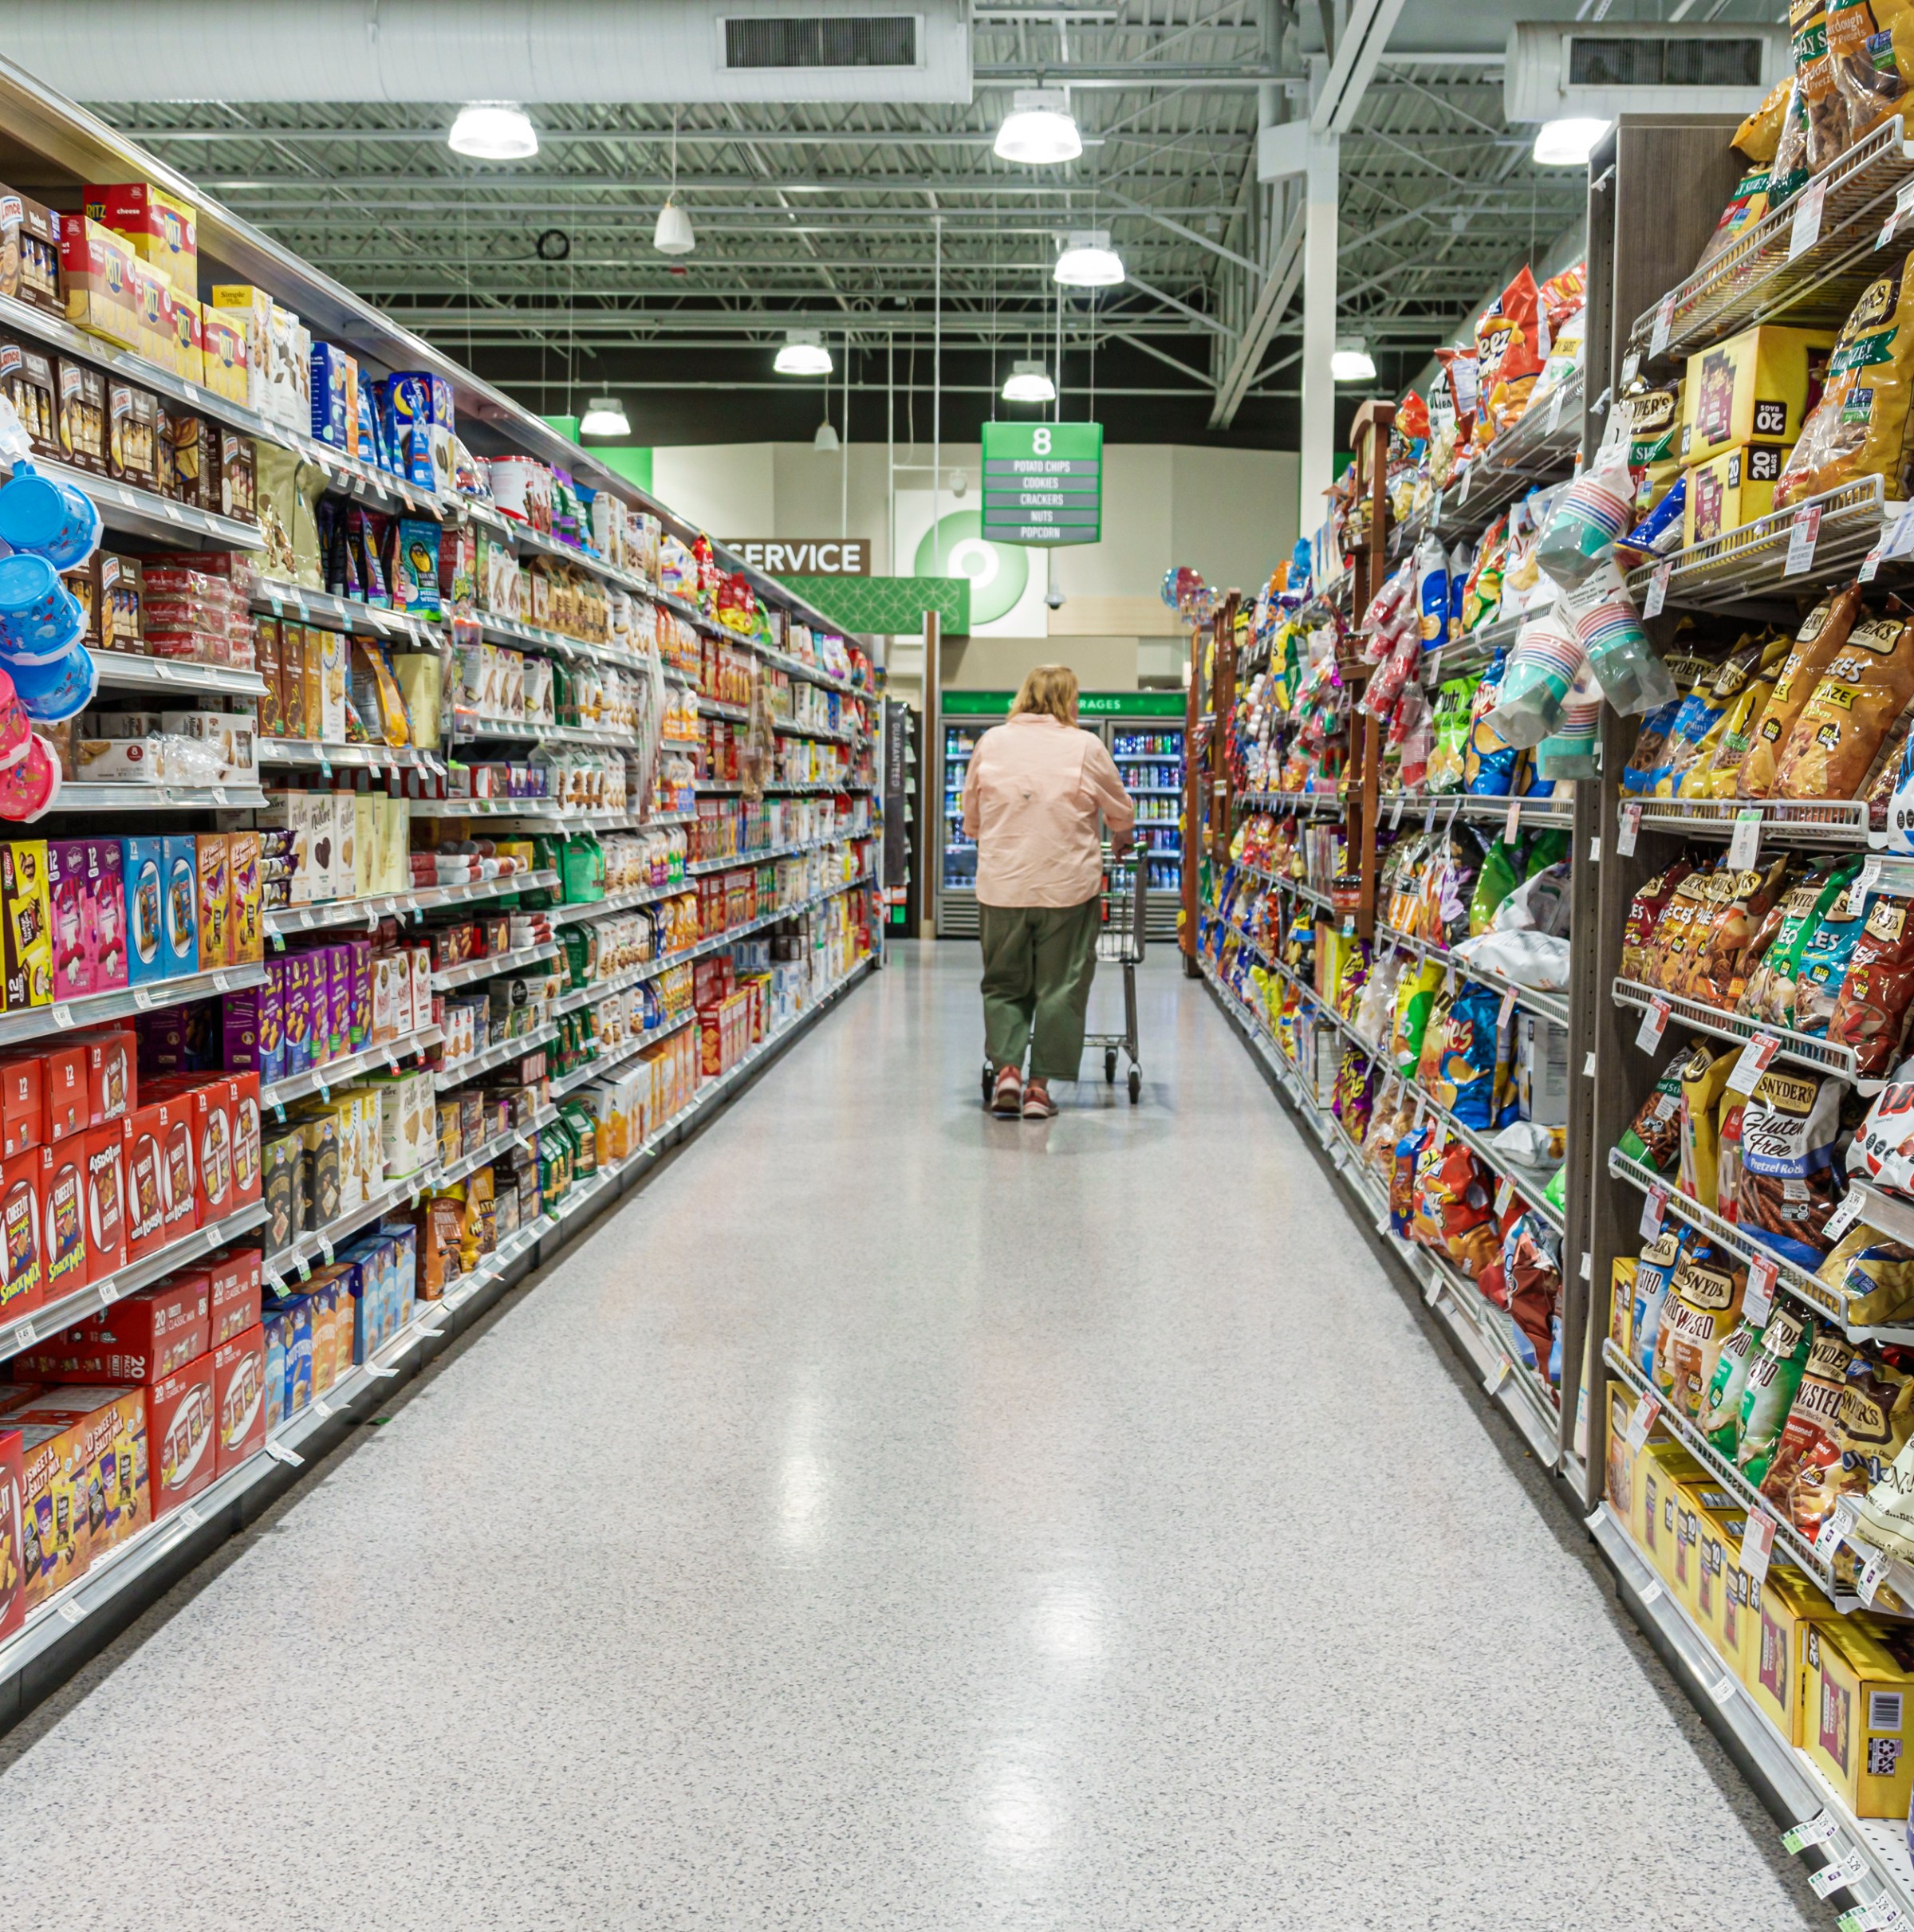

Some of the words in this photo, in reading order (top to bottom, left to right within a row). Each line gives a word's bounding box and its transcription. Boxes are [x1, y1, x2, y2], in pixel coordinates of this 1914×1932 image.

[86, 204, 106, 218] RITZ
[220, 291, 245, 300] Simple
[1480, 328, 1512, 358] eez
[1635, 398, 1670, 417] YDER'S
[1756, 412, 1784, 431] 20
[1032, 427, 1052, 455] 8
[1014, 460, 1043, 472] POTATO
[1045, 460, 1071, 473] CHIPS
[1729, 458, 1739, 478] 20
[1752, 451, 1770, 478] 20
[1022, 477, 1059, 489] COOKIES
[1020, 494, 1064, 506] CRACKERS
[1030, 510, 1053, 522] NUTS
[1020, 526, 1061, 538] POPCORN
[1855, 620, 1896, 640] DER'S
[1721, 667, 1743, 689] DER'S
[1774, 683, 1786, 695] ZE
[1080, 699, 1121, 710] RAGES
[1766, 722, 1779, 734] BIG
[131, 746, 139, 755] 8
[891, 722, 901, 788] GUARANTEED
[49, 850, 58, 872] 12
[89, 848, 97, 869] 12
[1684, 876, 1709, 893] DER'S
[1789, 891, 1816, 908] SNYDE
[1814, 966, 1829, 977] BIG
[9, 978, 19, 1002] 12
[1857, 982, 1868, 994] BIG
[93, 1048, 101, 1062] 12
[65, 1064, 74, 1080] 12
[19, 1077, 28, 1094] 12
[1758, 1076, 1814, 1104] SNYDER'S
[199, 1094, 207, 1107] 12
[1878, 1084, 1914, 1116] BB
[124, 1118, 132, 1132] 12
[1743, 1112, 1806, 1136] Gluten
[1747, 1133, 1792, 1157] Free
[43, 1147, 53, 1163] 12
[1751, 1157, 1779, 1174] Pretzel
[1781, 1163, 1804, 1175] Rods
[479, 1202, 495, 1212] ATH
[214, 1280, 223, 1298] 20
[1640, 1269, 1663, 1295] STED
[156, 1309, 166, 1328] 20
[1810, 1342, 1846, 1371] NYDE
[131, 1356, 145, 1379] 20
[156, 1385, 164, 1399] 20
[1786, 1420, 1813, 1438] Seasoned
[28, 1450, 49, 1483] SWEET
[30, 1468, 49, 1501] SALTY
[48, 1455, 61, 1481] MIX
[1688, 1516, 1695, 1535] 10
[1712, 1544, 1720, 1564] 10
[1739, 1573, 1747, 1595] 10
[1817, 1814, 1829, 1828] 5.29
[1846, 1855, 1861, 1872] 5.29
[1876, 1896, 1889, 1911] 5.29
